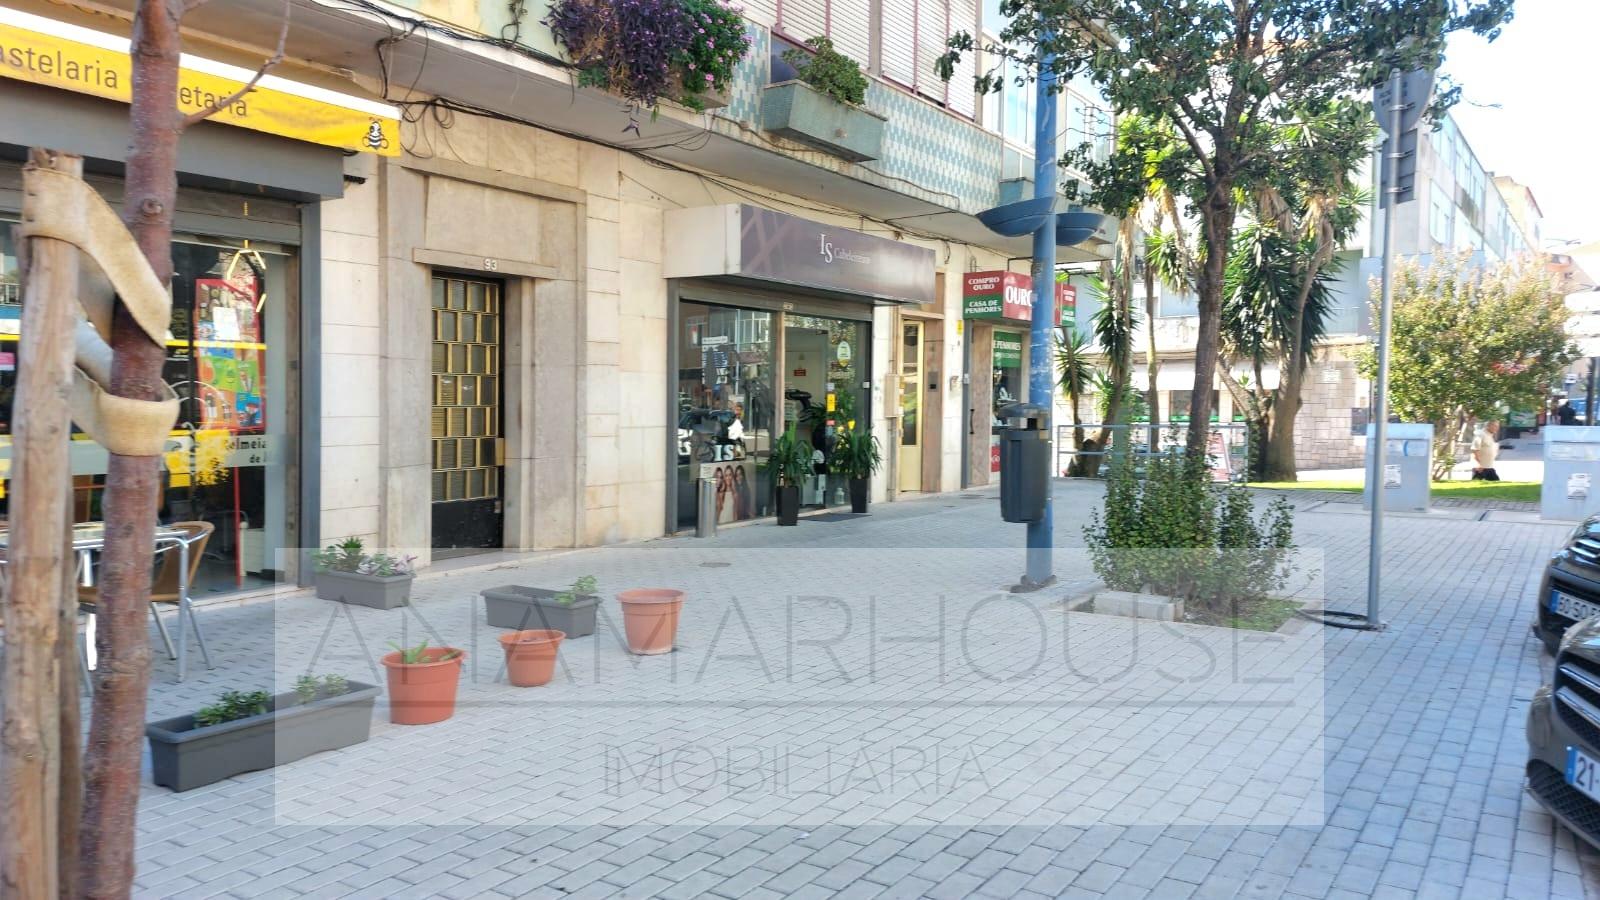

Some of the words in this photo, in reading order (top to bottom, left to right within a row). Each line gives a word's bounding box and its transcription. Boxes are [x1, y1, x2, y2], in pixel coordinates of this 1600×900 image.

[0, 45, 118, 89] stelaria
[484, 258, 497, 271] 93
[968, 277, 999, 285] COMPRO
